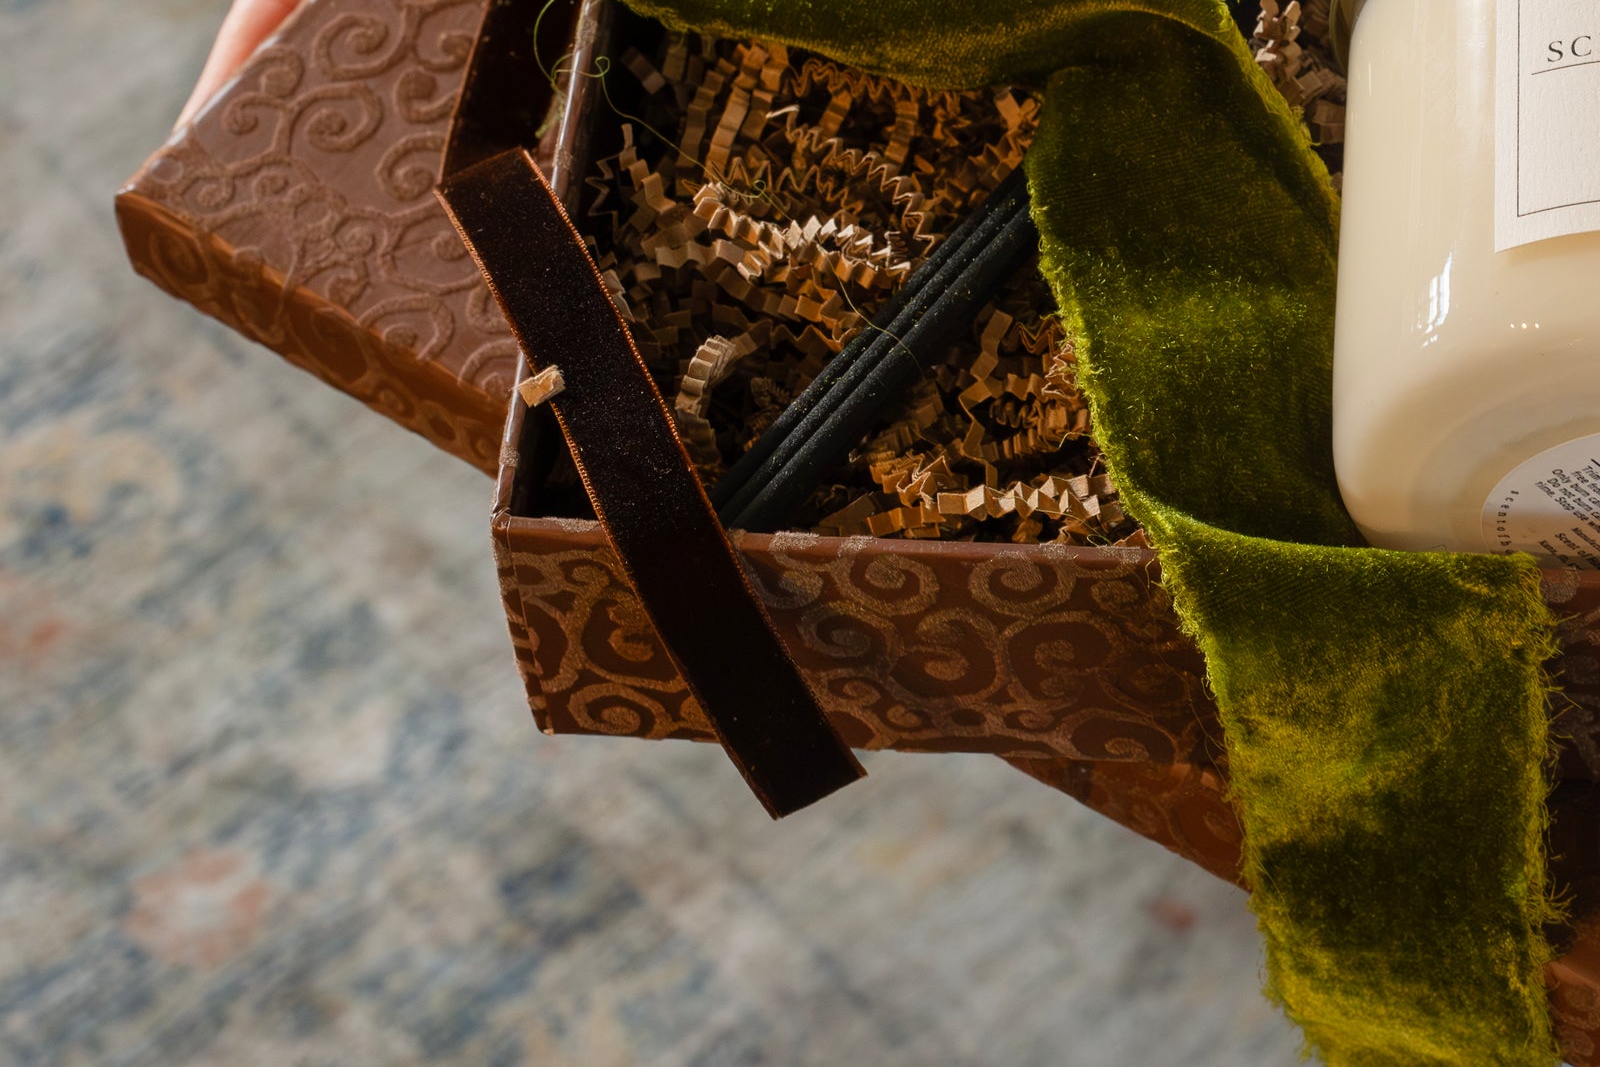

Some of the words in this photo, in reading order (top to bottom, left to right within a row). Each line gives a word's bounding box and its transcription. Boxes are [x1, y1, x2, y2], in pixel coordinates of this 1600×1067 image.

[1551, 468, 1571, 484] Only
[1569, 483, 1591, 497] burn
[1571, 470, 1590, 484] free
[1546, 477, 1564, 488] Do
[1559, 487, 1576, 499] not
[1572, 497, 1593, 512] burn
[1554, 496, 1575, 511] Stop
[1572, 510, 1590, 522] use
